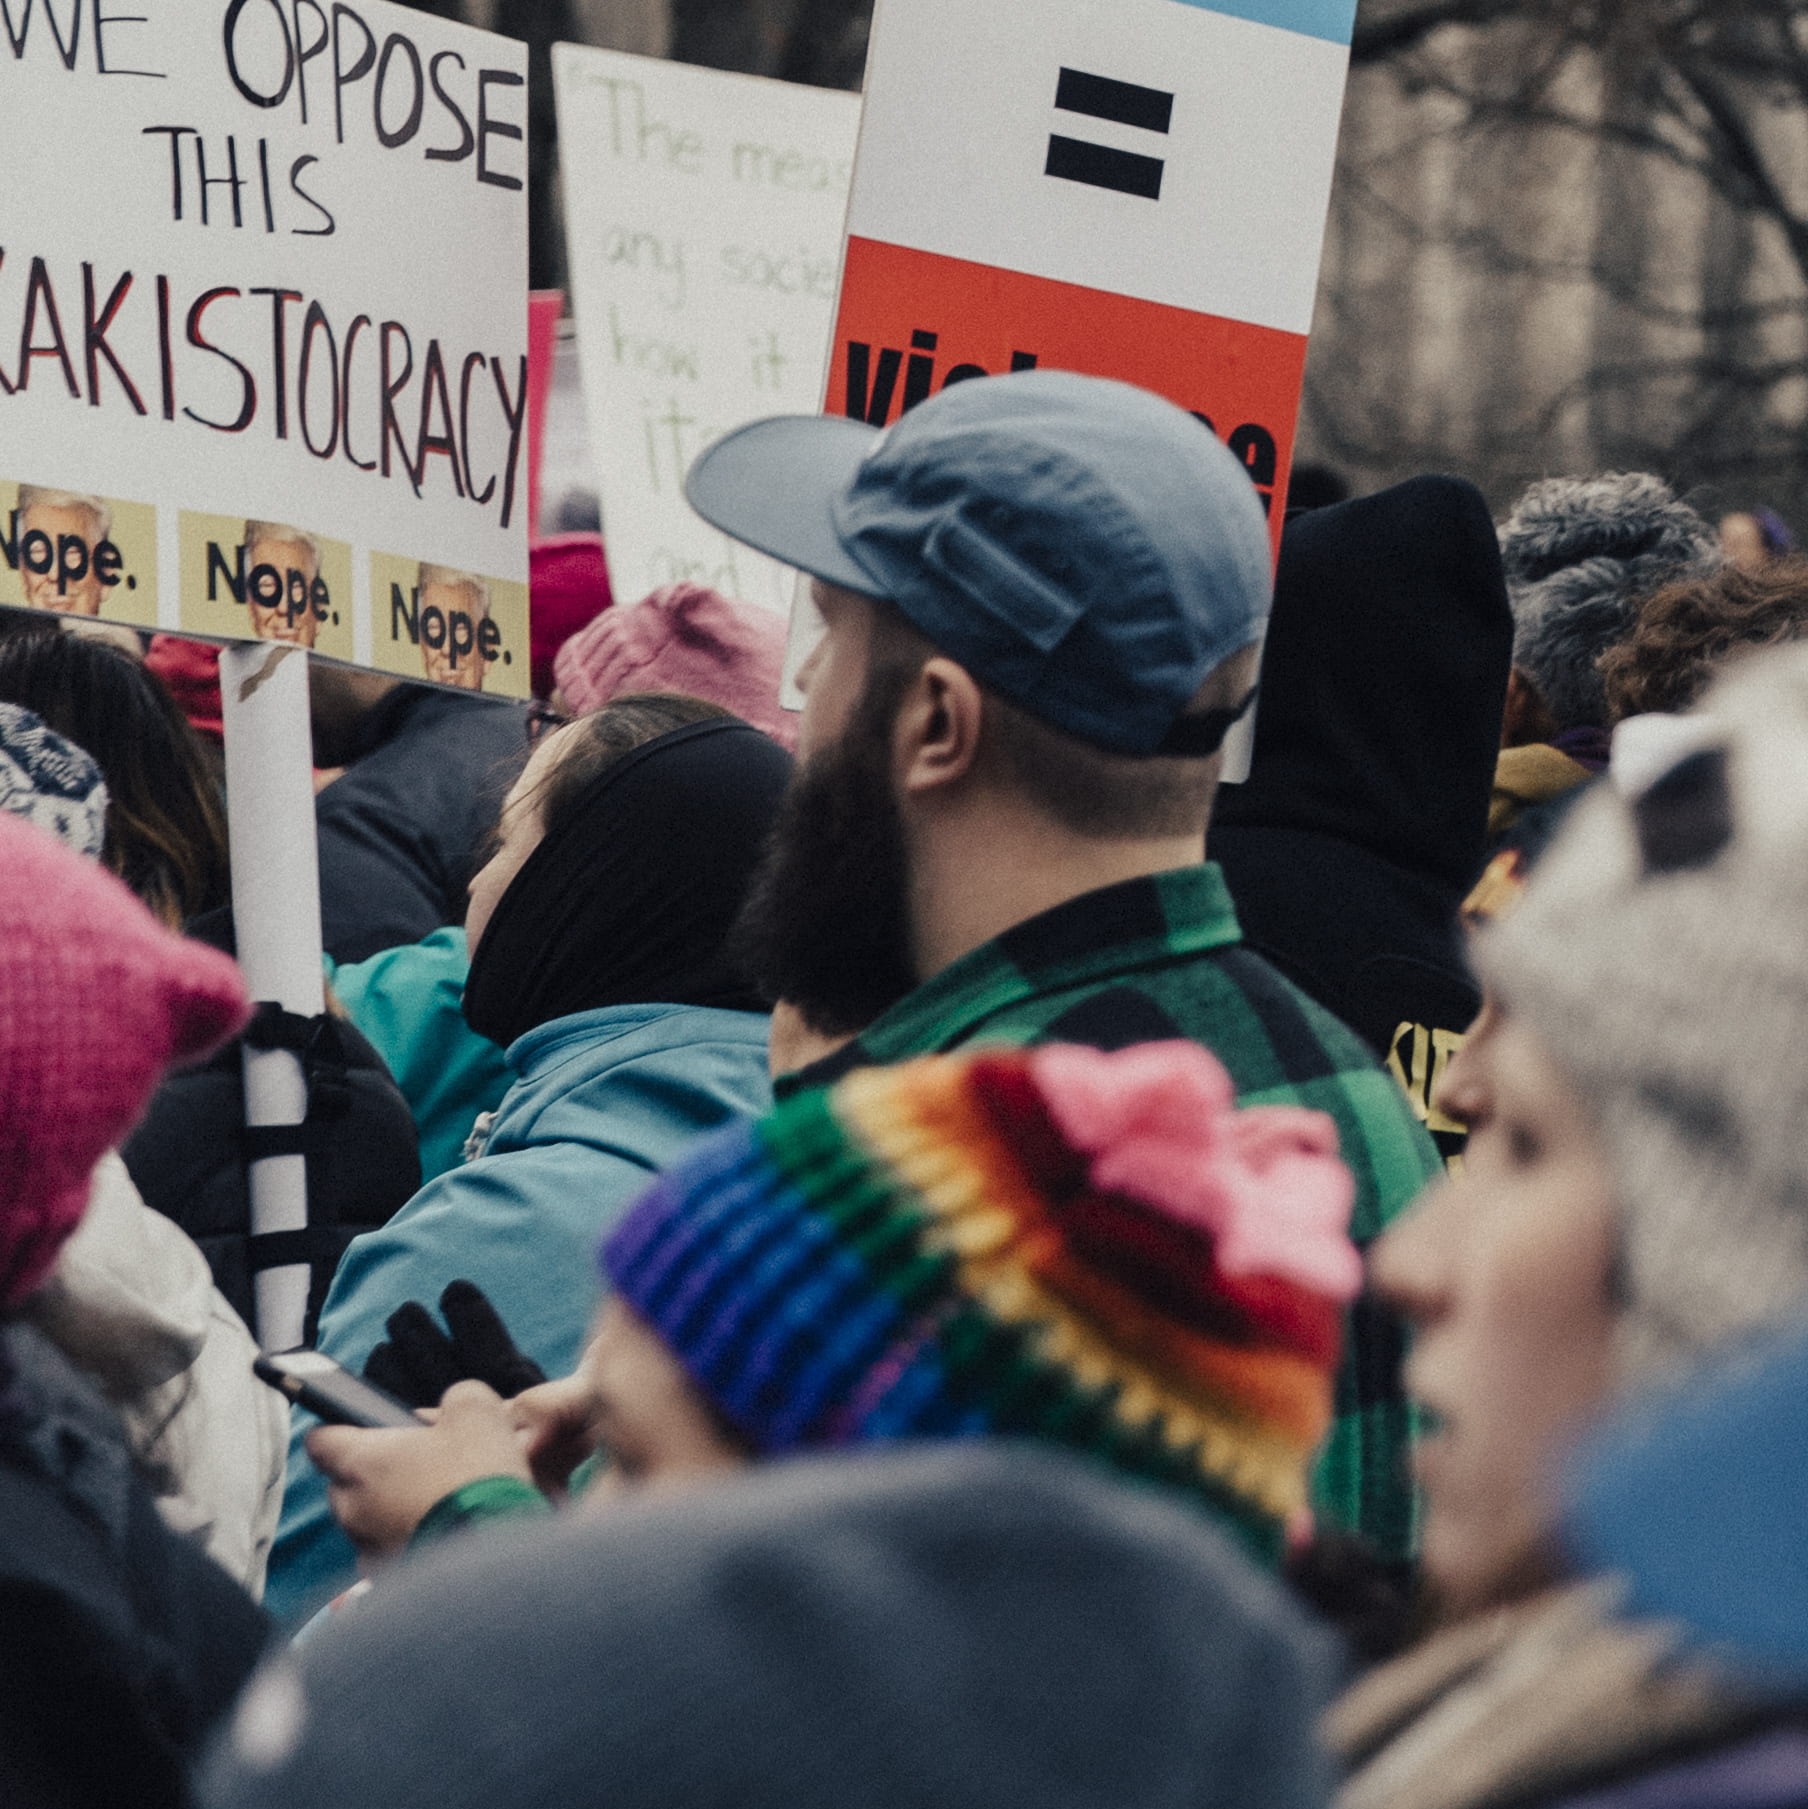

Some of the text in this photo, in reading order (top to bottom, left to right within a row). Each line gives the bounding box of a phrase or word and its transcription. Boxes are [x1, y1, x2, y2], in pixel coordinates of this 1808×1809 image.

[143, 126, 335, 235] THIS
[0, 247, 527, 528] AKISTOCRACY
[207, 541, 340, 628] Nope.
[390, 582, 512, 671] Nope.
